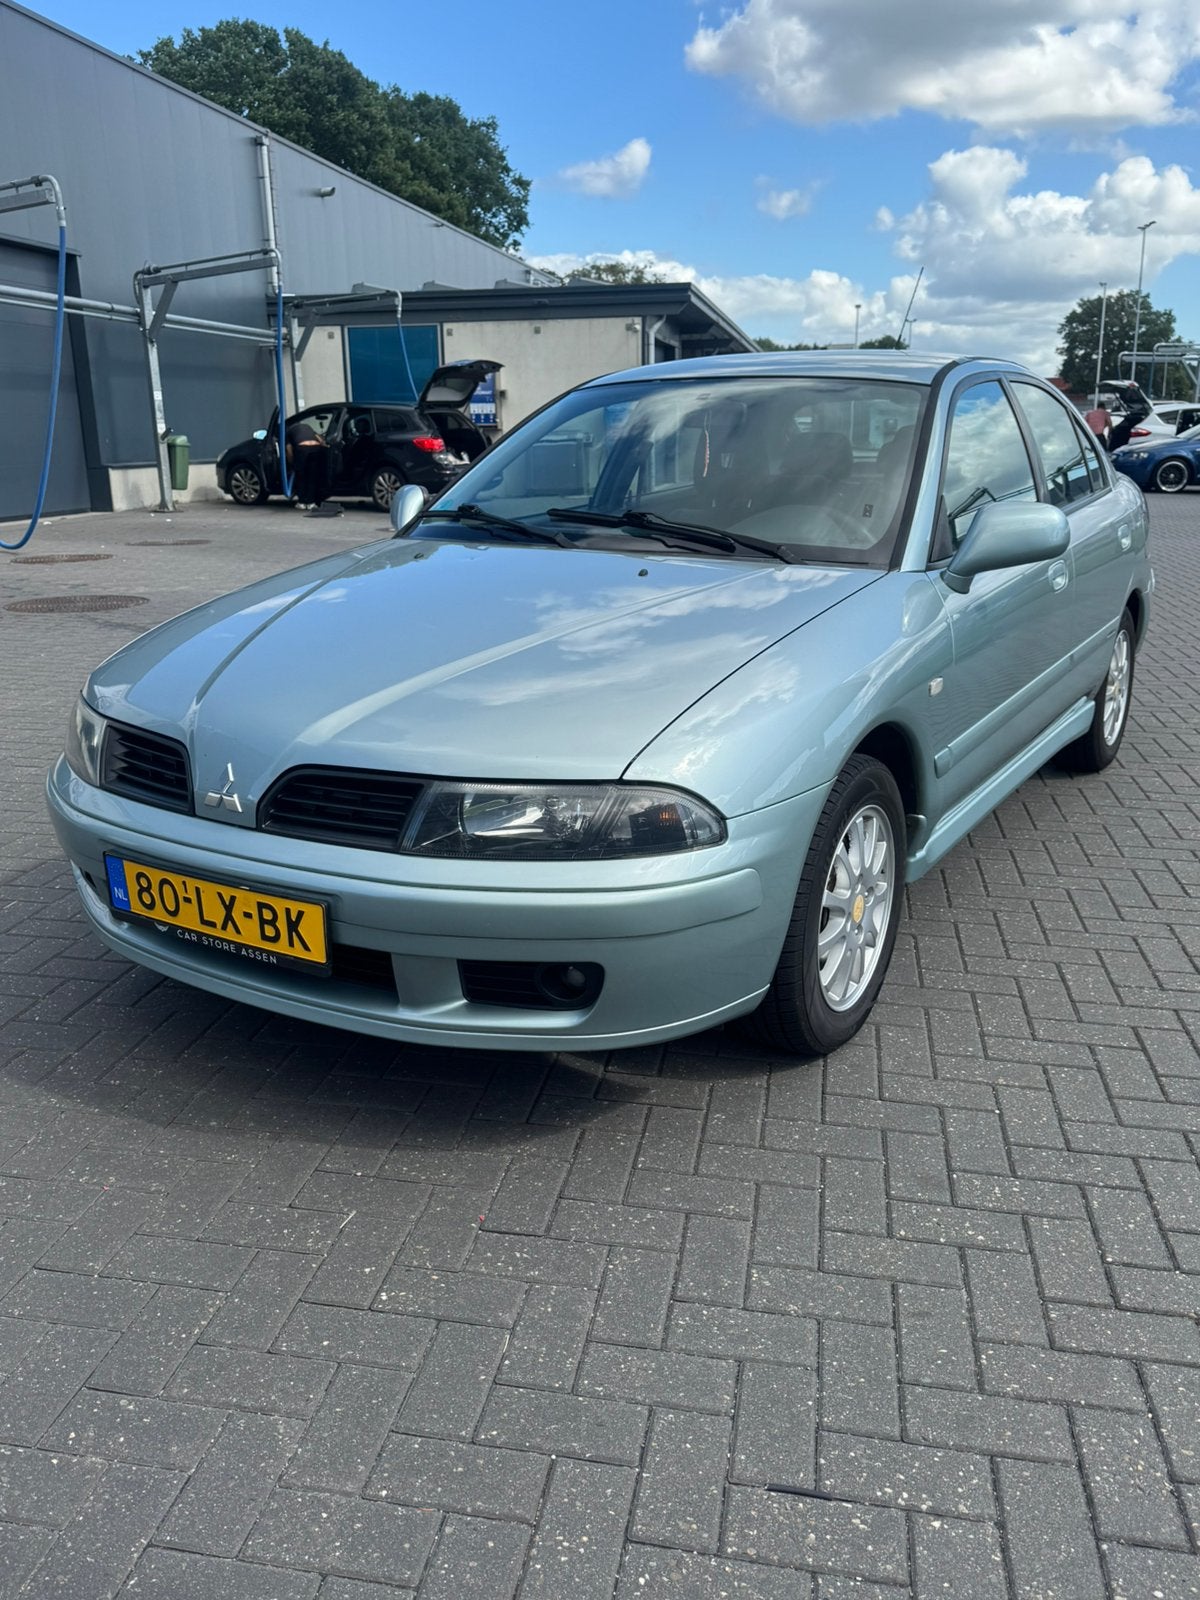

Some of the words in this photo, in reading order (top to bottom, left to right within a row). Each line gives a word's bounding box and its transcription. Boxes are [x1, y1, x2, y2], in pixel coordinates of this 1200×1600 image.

[113, 887, 128, 901] NL
[135, 871, 311, 952] 80-LX-BK
[176, 929, 198, 943] CAR
[202, 936, 237, 953] STORE
[242, 947, 277, 964] ASSEN
